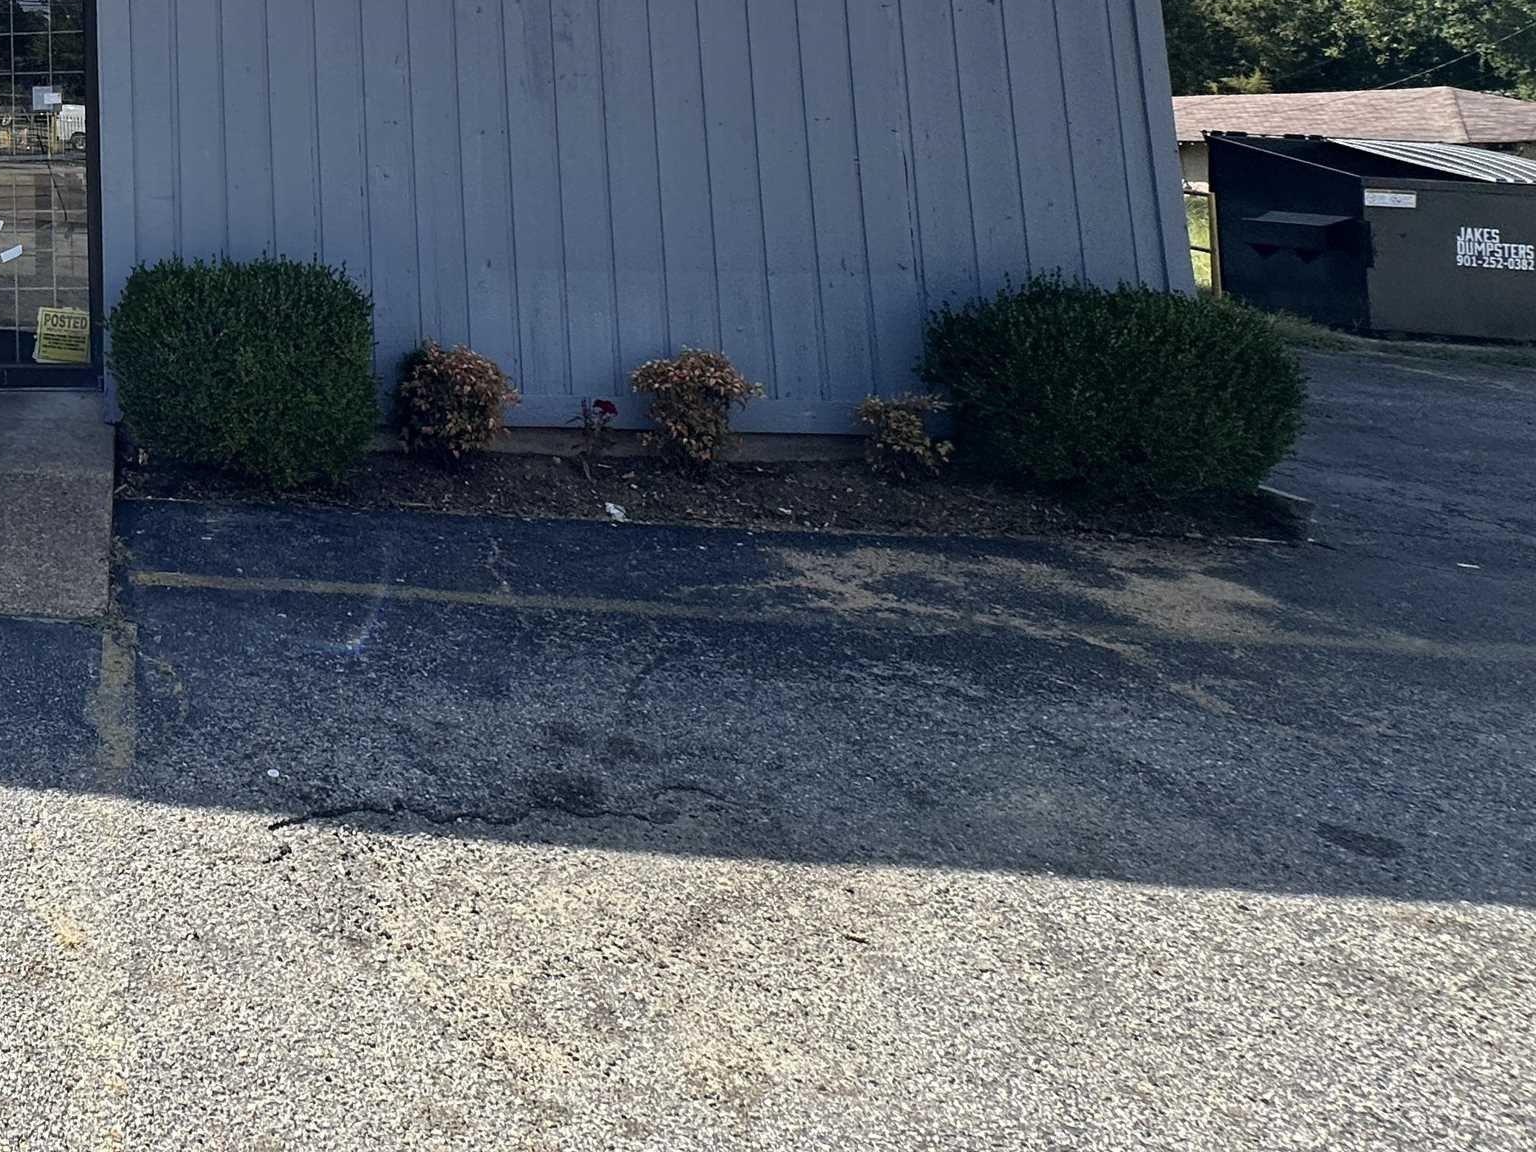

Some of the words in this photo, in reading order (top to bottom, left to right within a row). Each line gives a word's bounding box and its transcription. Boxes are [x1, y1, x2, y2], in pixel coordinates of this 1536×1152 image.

[1456, 226, 1500, 243] JAKES
[1456, 241, 1535, 259] DUMPSTERS
[1456, 254, 1535, 271] 901-252-0382
[43, 313, 88, 330] POSTED
